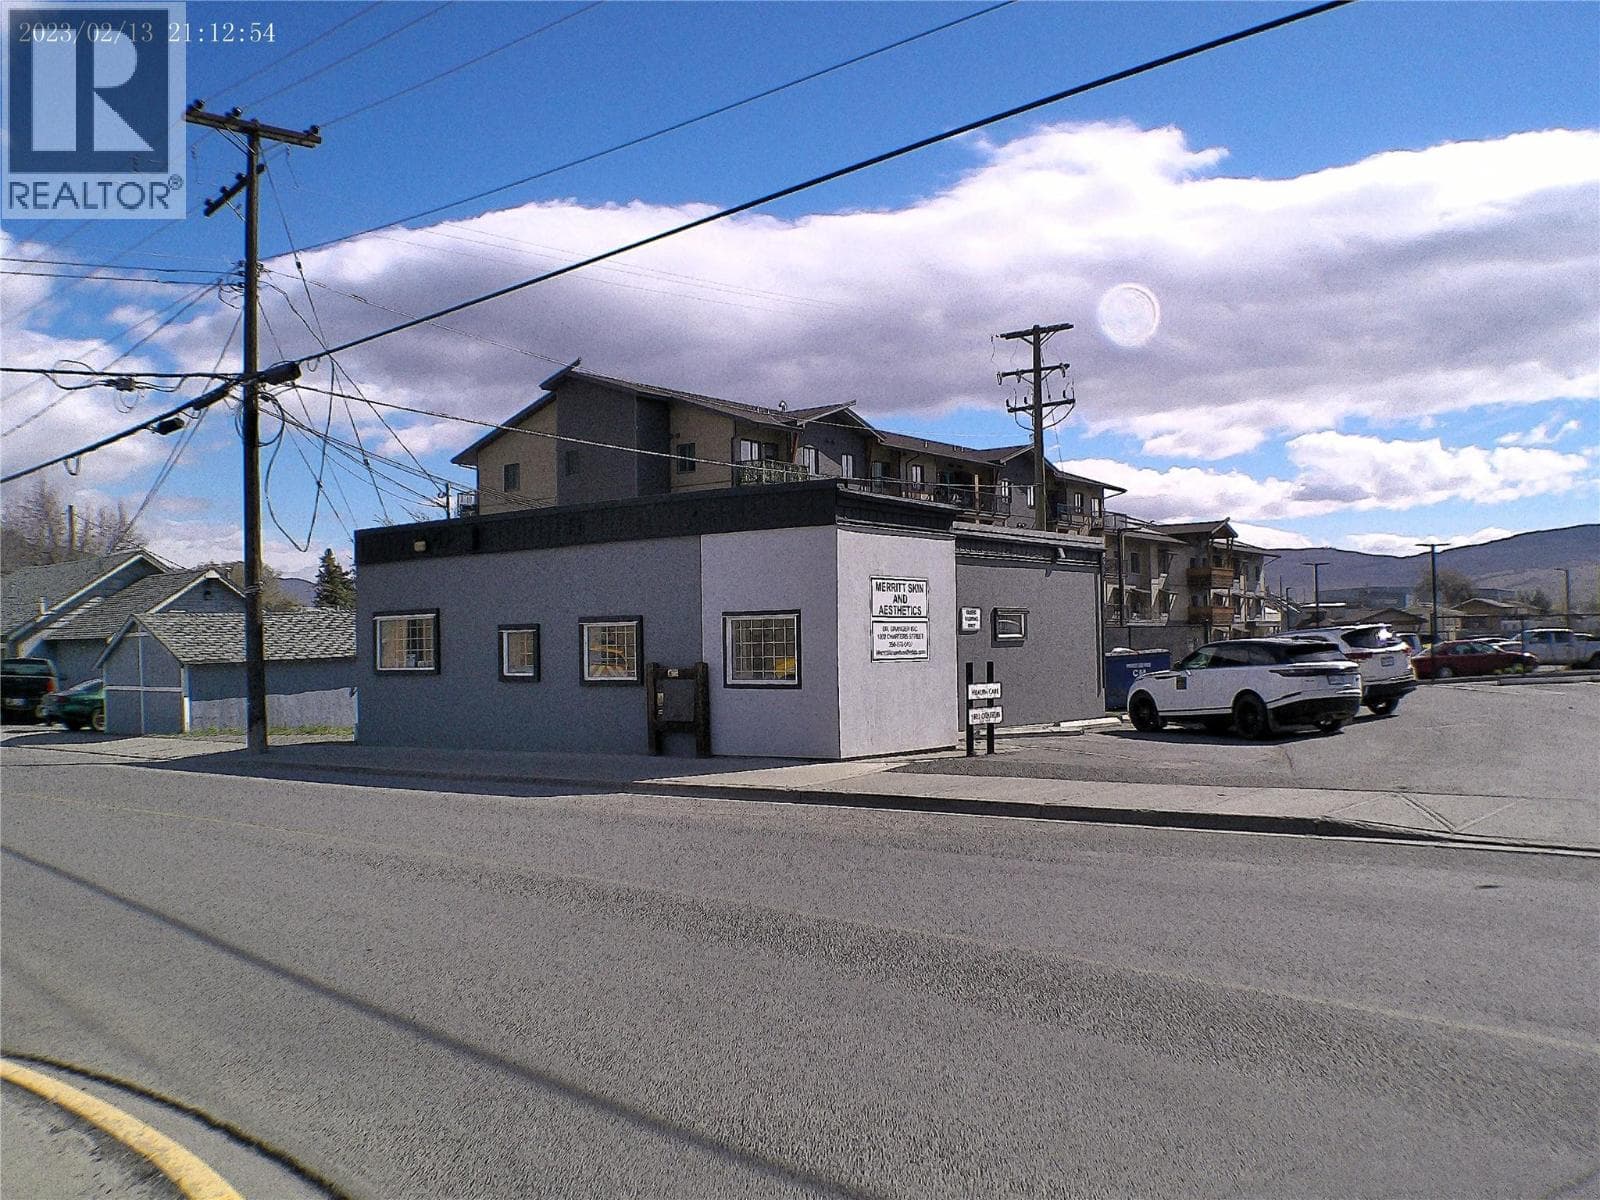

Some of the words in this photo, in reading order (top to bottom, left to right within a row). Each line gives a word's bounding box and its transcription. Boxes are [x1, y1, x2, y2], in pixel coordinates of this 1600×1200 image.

[876, 581, 906, 593] MERRITT
[908, 583, 924, 593] SKIN
[892, 594, 908, 604] AND
[878, 605, 922, 616] AESTHETICS
